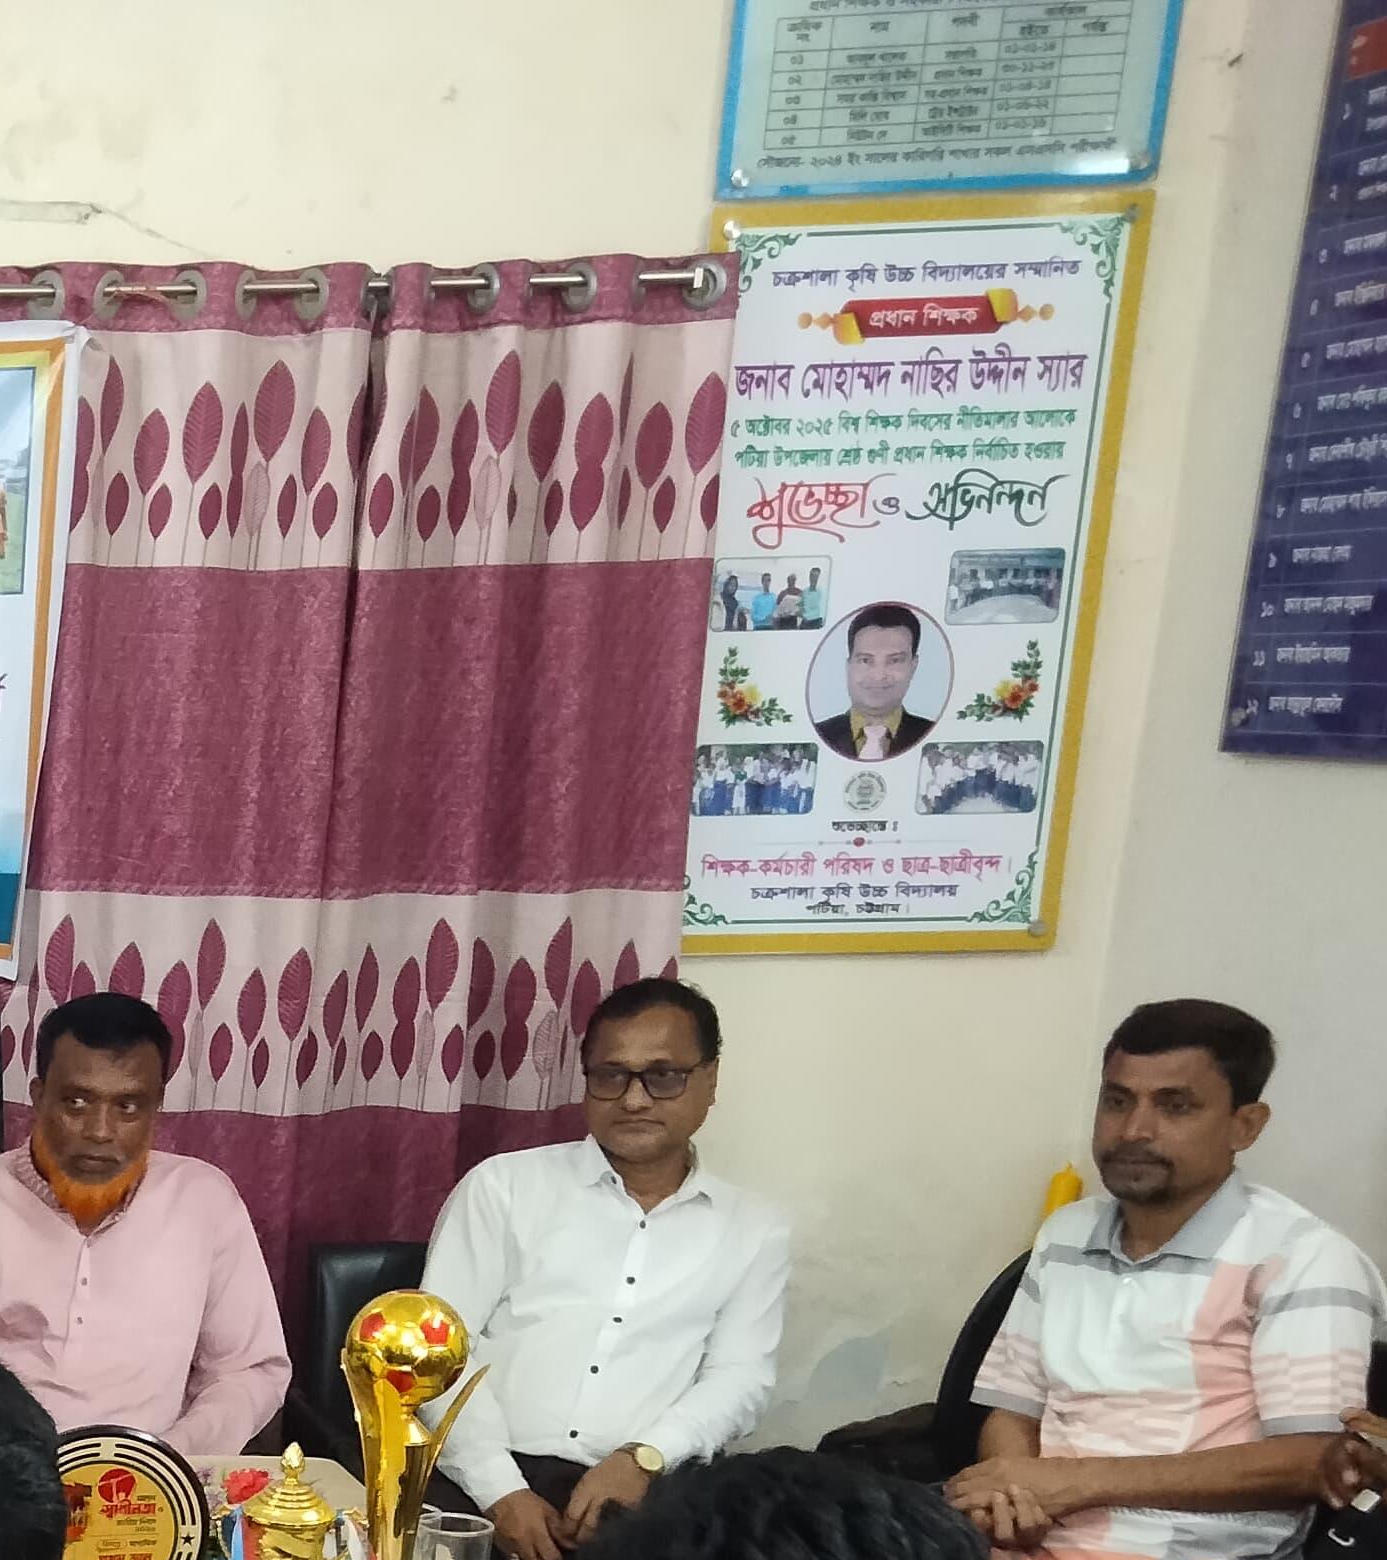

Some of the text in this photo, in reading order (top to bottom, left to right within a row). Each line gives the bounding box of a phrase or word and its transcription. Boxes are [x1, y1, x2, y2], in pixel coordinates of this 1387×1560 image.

[772, 256, 1082, 291] চক্রশালা কৃষি উচ্চ বিদ্যালয়ের সম্মানিত
[869, 303, 979, 328] প্রধান শিক্ষক
[734, 342, 1088, 402] জনাব মোহাম্মদ নাছির উদ্দীন স্যার
[730, 420, 740, 437] ৫
[745, 414, 792, 436] অক্টোবর
[796, 418, 833, 436] ২০২৫
[746, 468, 1075, 549] শুভেচ্ছা ও অভিনন্দন
[701, 851, 817, 880] শিক্ষক-কর্মচারী
[823, 851, 875, 877] পরিষদ
[883, 860, 894, 875] ও
[750, 881, 958, 902] চক্রশালা কৃষি উচ্চ বিদ্যালয়
[100, 1498, 157, 1519] স্বাধীনতা
